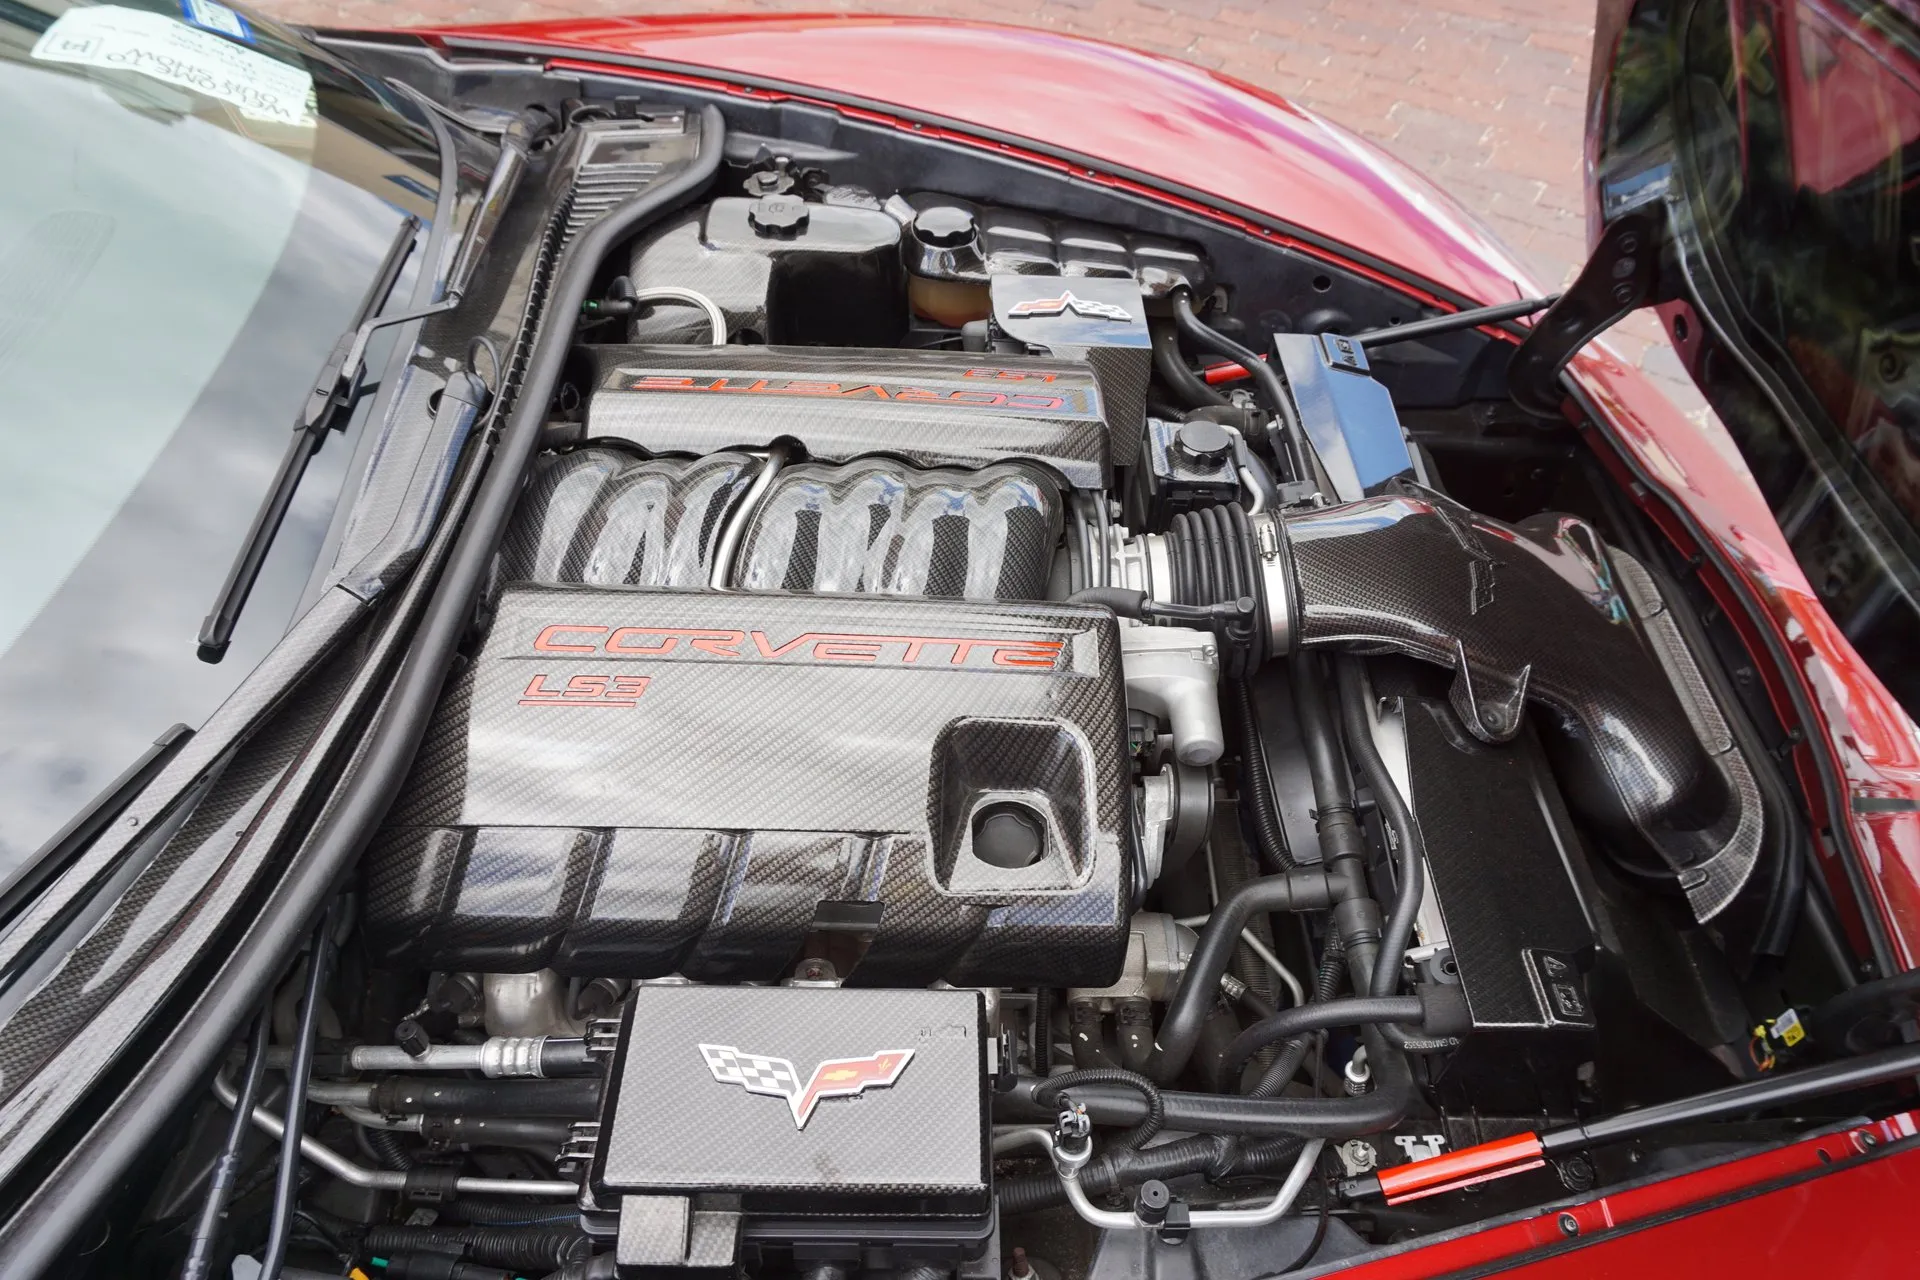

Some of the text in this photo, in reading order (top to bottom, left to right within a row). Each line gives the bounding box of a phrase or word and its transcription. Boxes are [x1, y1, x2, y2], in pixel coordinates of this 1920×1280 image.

[126, 47, 214, 81] SHOW
[158, 64, 291, 119] WELCOME
[961, 367, 1059, 383] LS3
[631, 375, 1065, 410] CORVETTE
[533, 624, 1066, 668] CORVETTE
[523, 673, 653, 699] LS3
